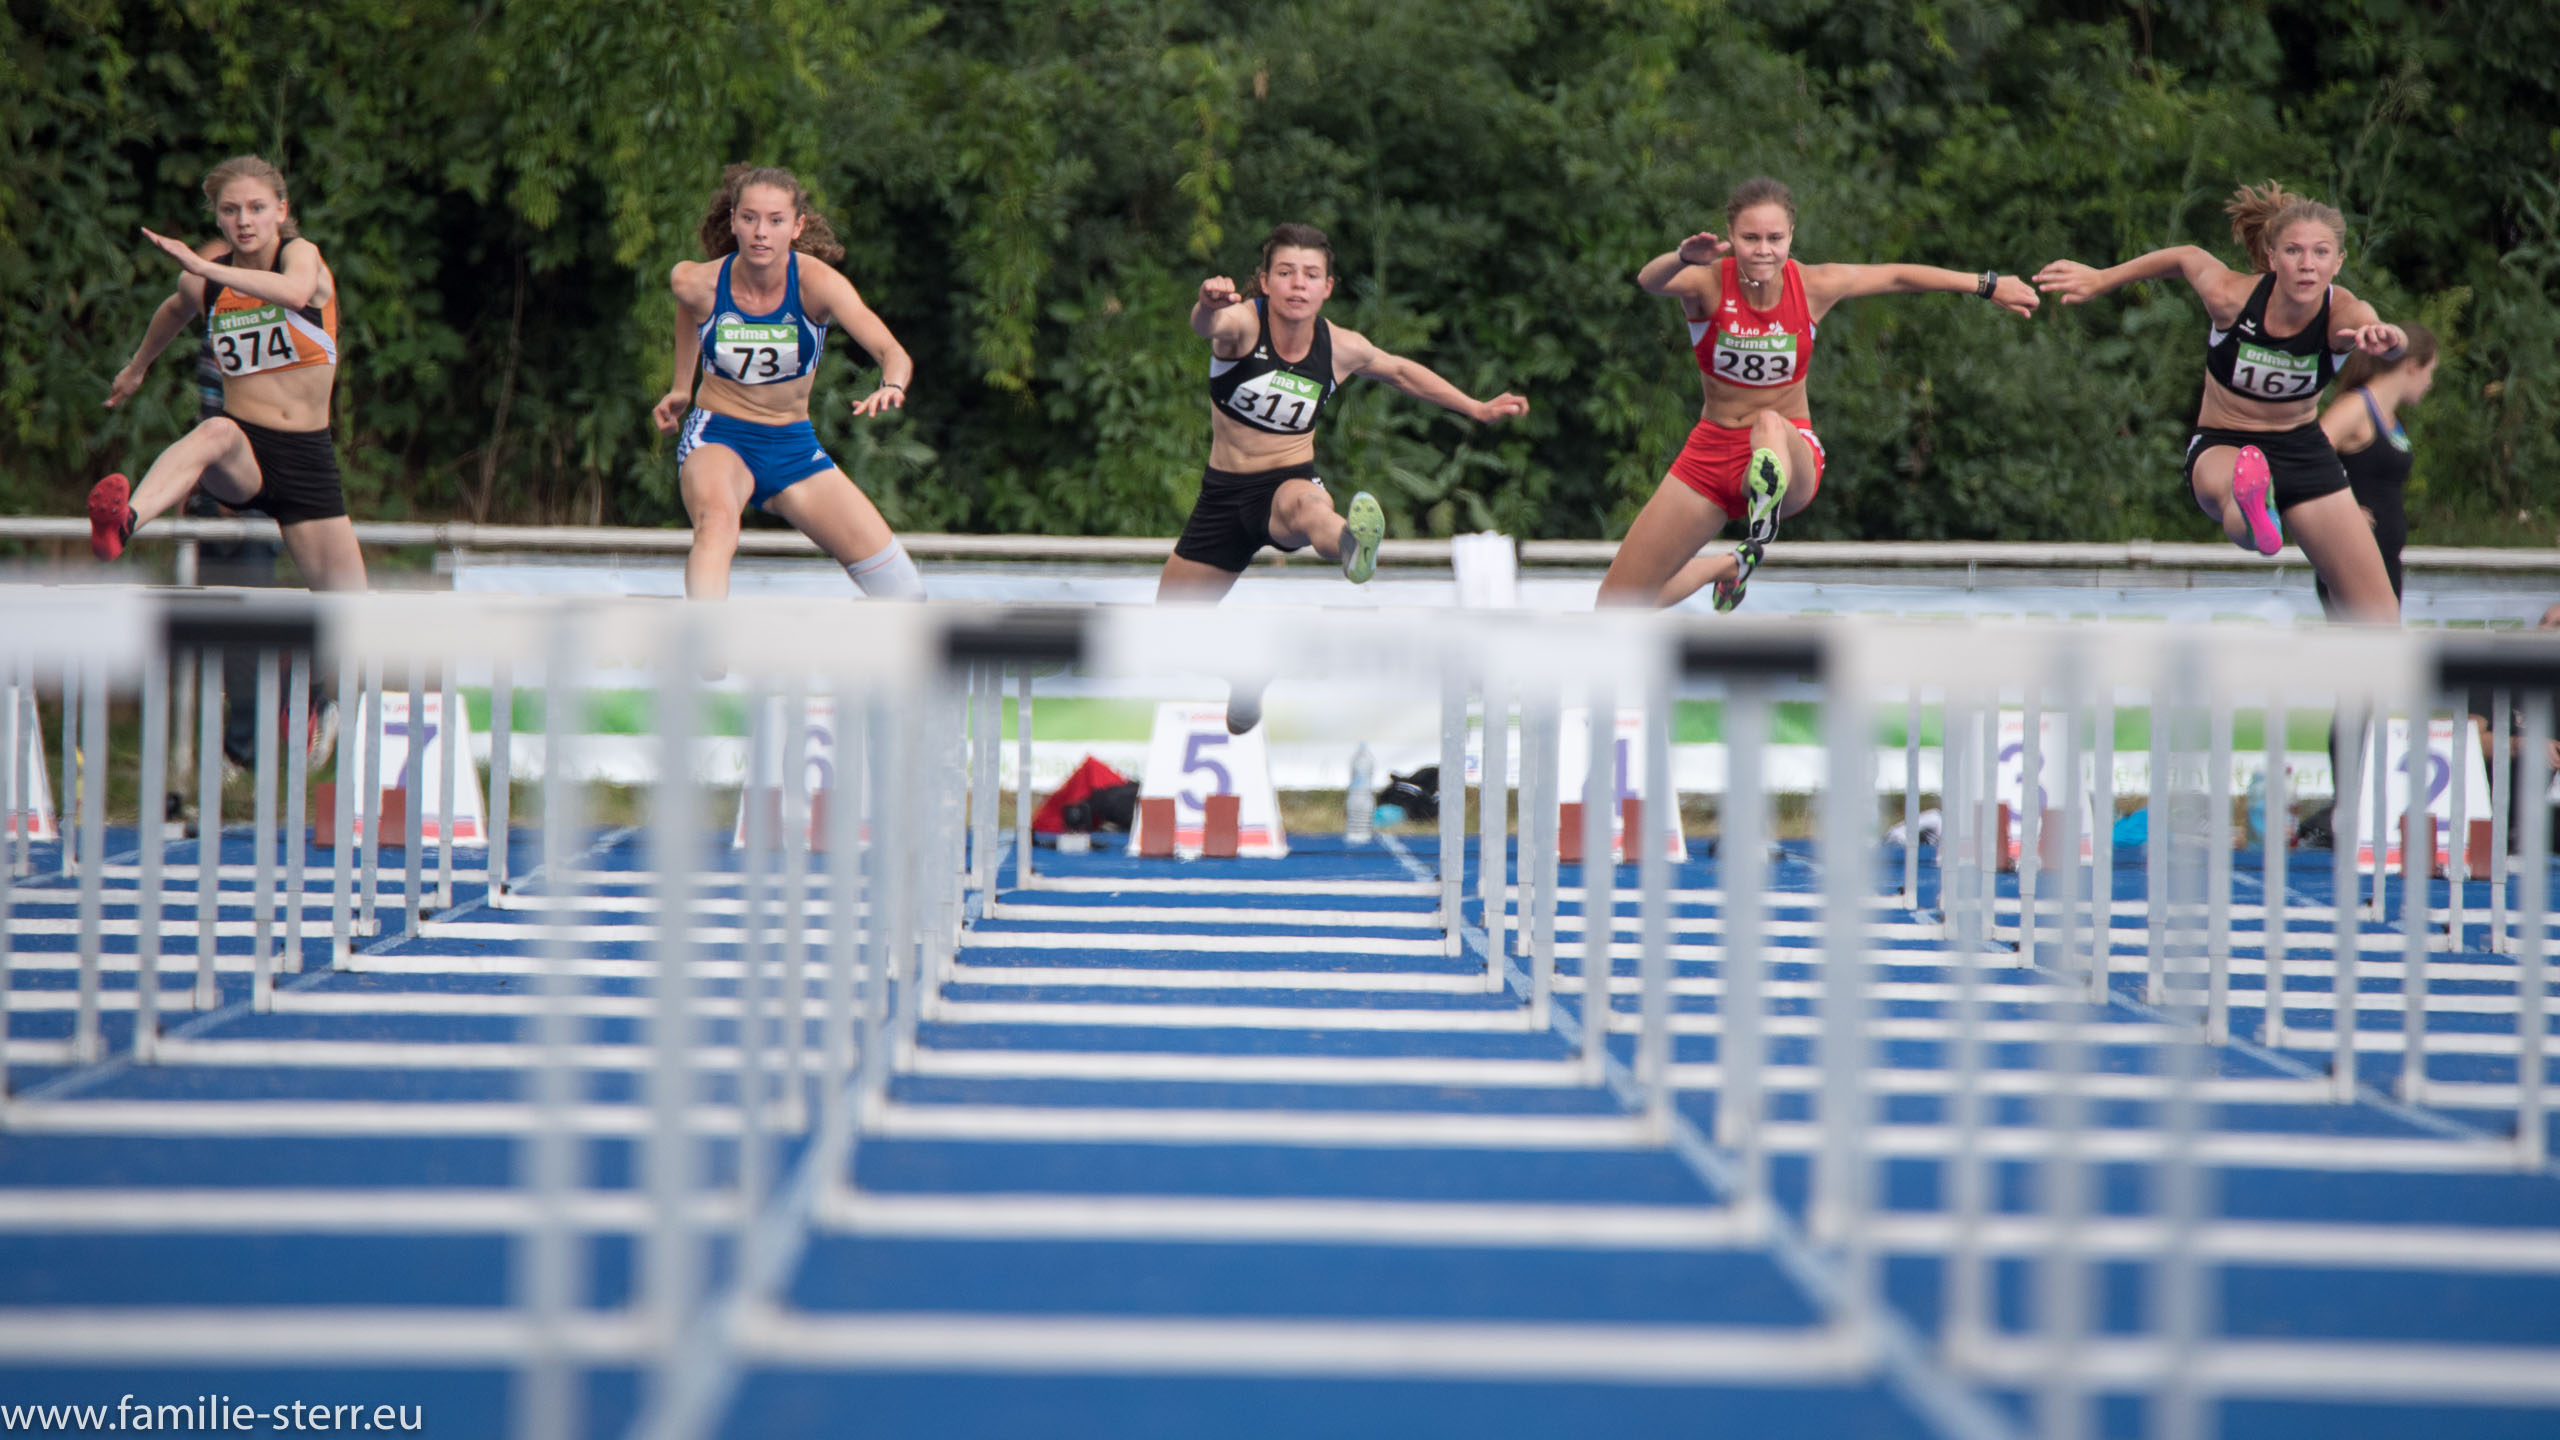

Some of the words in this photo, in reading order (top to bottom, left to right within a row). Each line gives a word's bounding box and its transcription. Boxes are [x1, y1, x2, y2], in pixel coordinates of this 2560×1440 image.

[218, 326, 293, 371] 374
[724, 328, 769, 340] erima
[1725, 337, 1769, 350] erima
[732, 347, 780, 380] 73
[1719, 351, 1790, 381] 283
[2246, 348, 2291, 367] erima
[2240, 366, 2312, 394] 167
[1234, 387, 1306, 429] 311
[1181, 734, 1232, 811] 5
[1998, 743, 2048, 821] 3
[2396, 753, 2450, 831] 2
